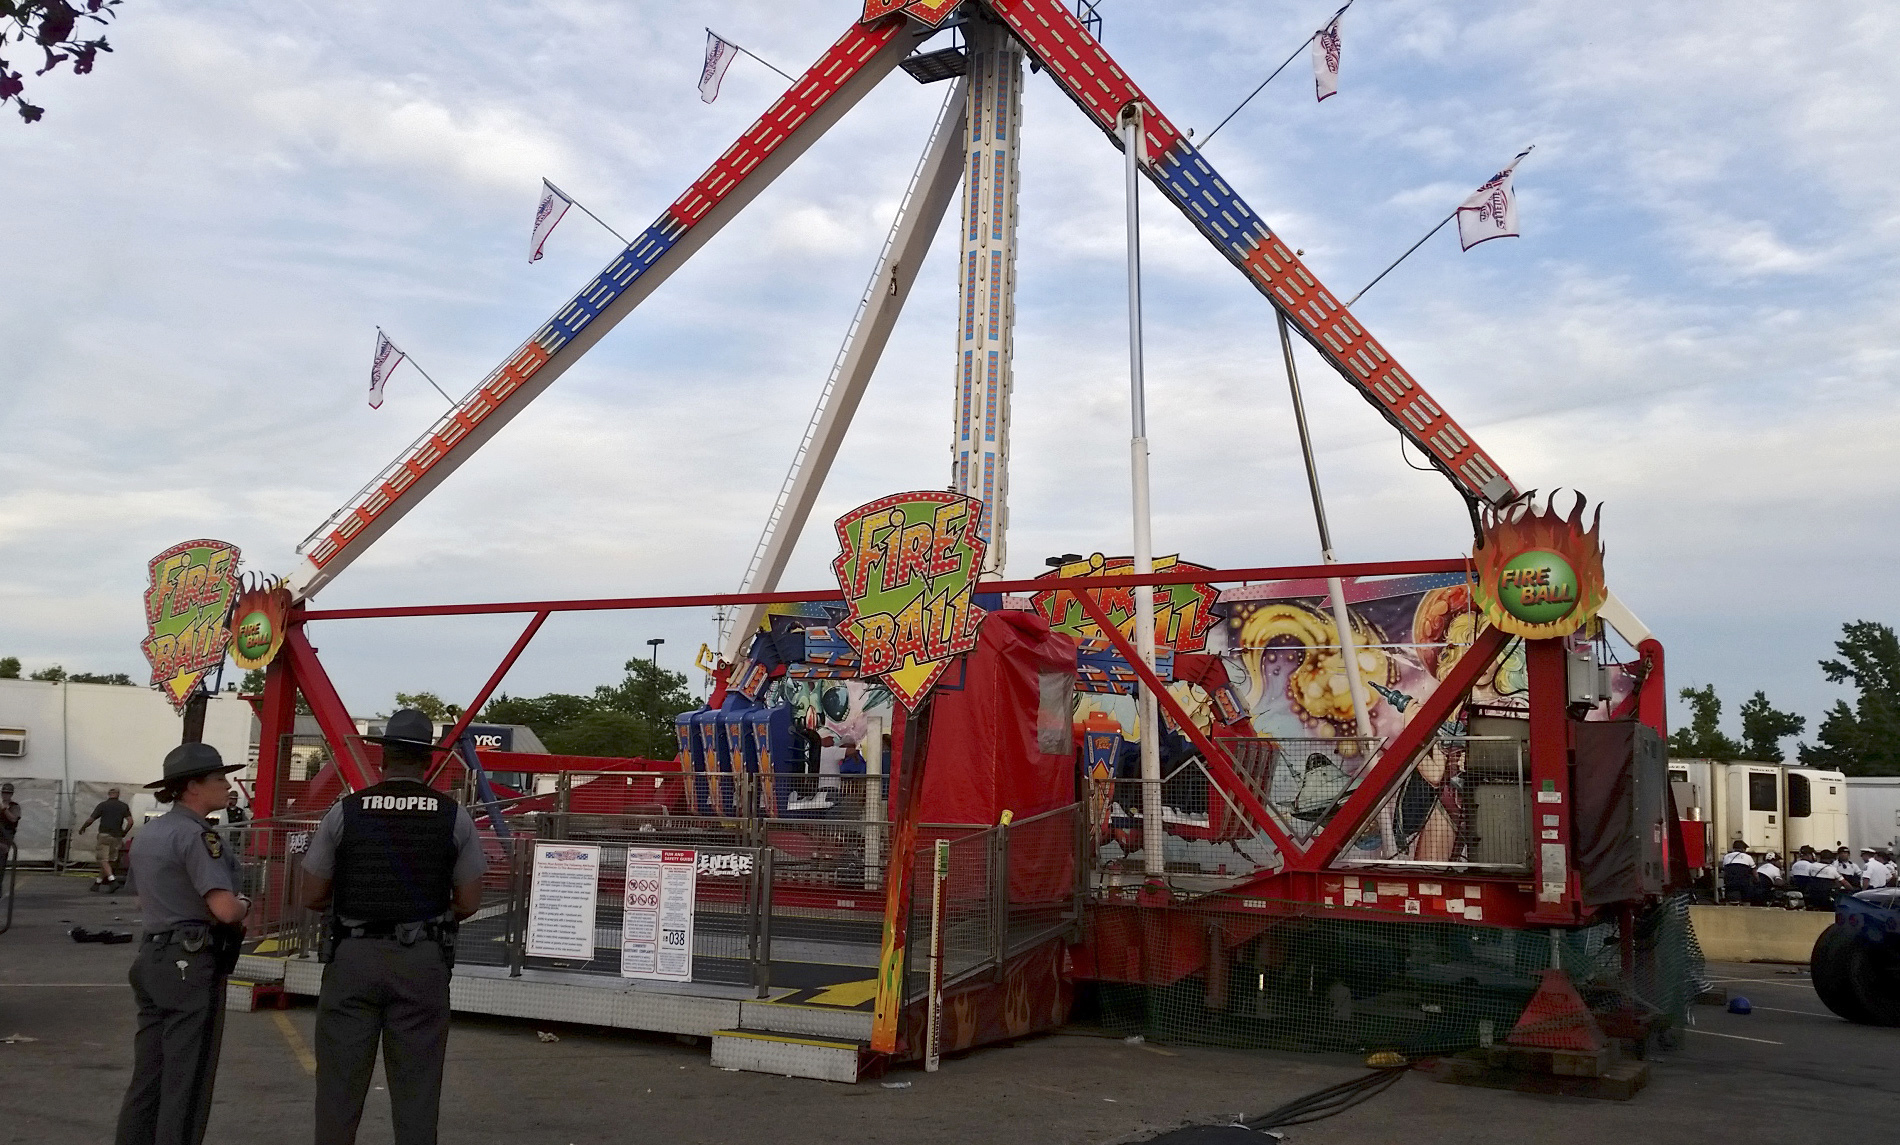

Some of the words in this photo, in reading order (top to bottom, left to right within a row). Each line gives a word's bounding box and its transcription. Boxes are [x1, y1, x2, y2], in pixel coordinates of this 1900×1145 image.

[1501, 567, 1551, 589] FIRE
[1520, 583, 1574, 606] BALL
[239, 622, 261, 636] FIRE
[855, 580, 977, 679] BALL
[150, 610, 227, 686] BALL
[246, 631, 270, 648] BALL
[474, 735, 502, 746] YRC
[361, 795, 438, 811] TROOPER
[701, 853, 750, 870] ENTER
[669, 931, 685, 946] 038
